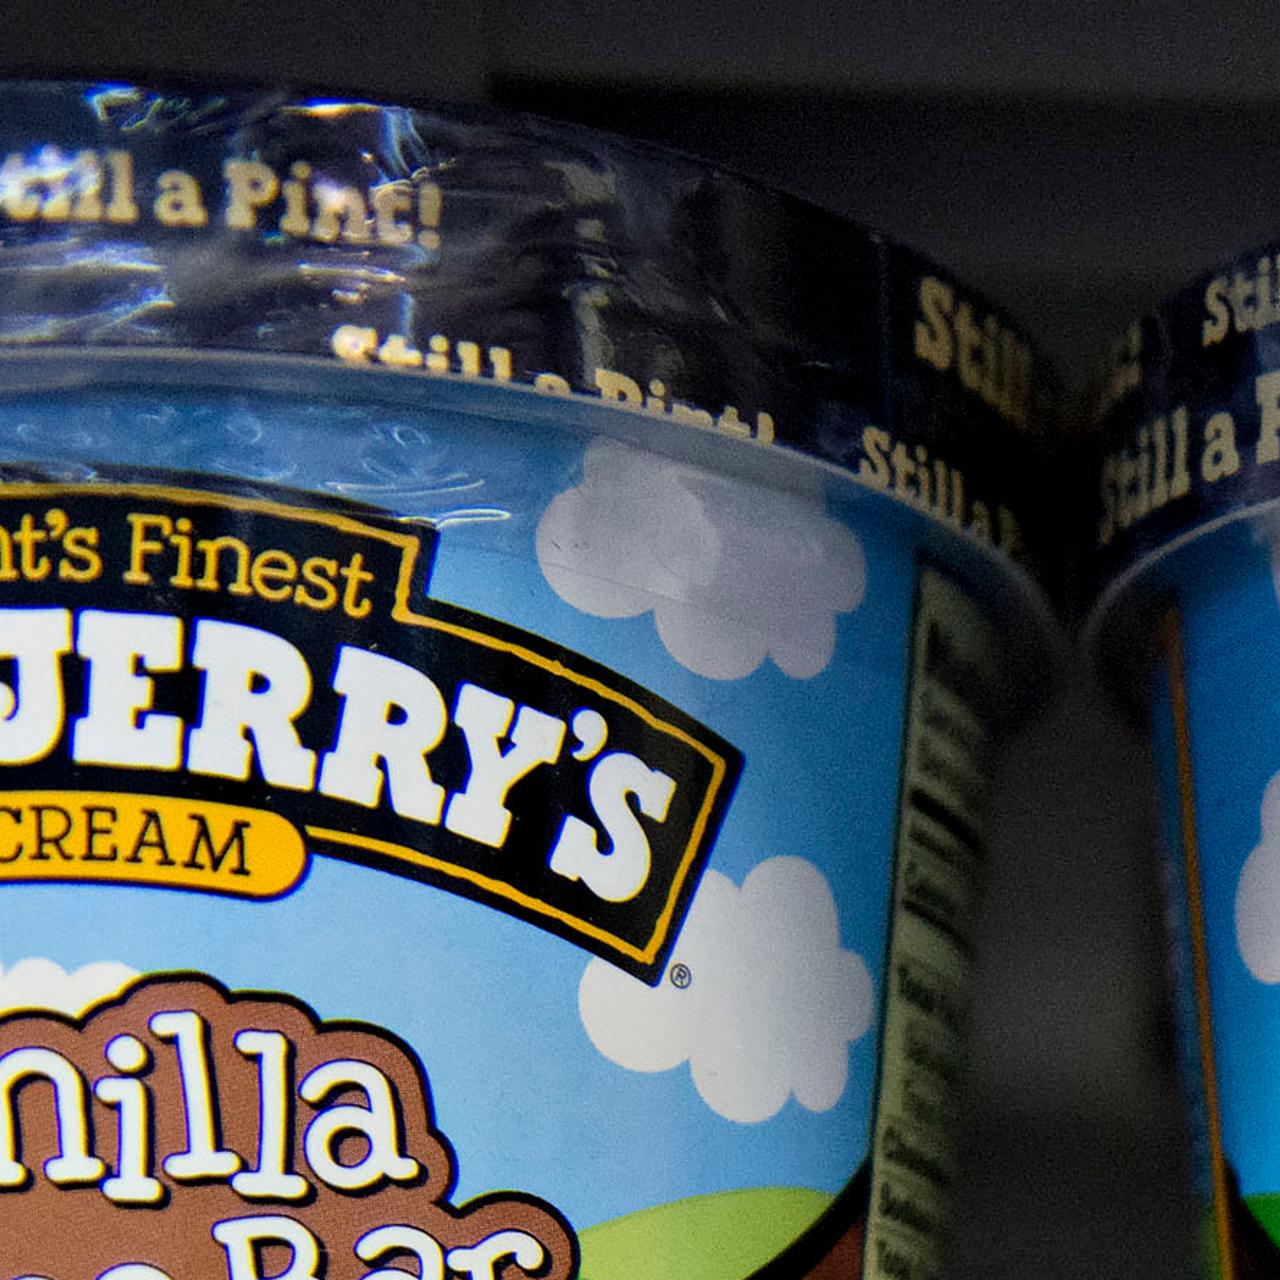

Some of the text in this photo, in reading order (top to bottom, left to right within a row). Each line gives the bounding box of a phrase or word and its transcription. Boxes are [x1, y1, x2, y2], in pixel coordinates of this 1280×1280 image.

[153, 158, 443, 251] a Pint!
[1202, 409, 1241, 484] a
[121, 513, 375, 620] Finest
